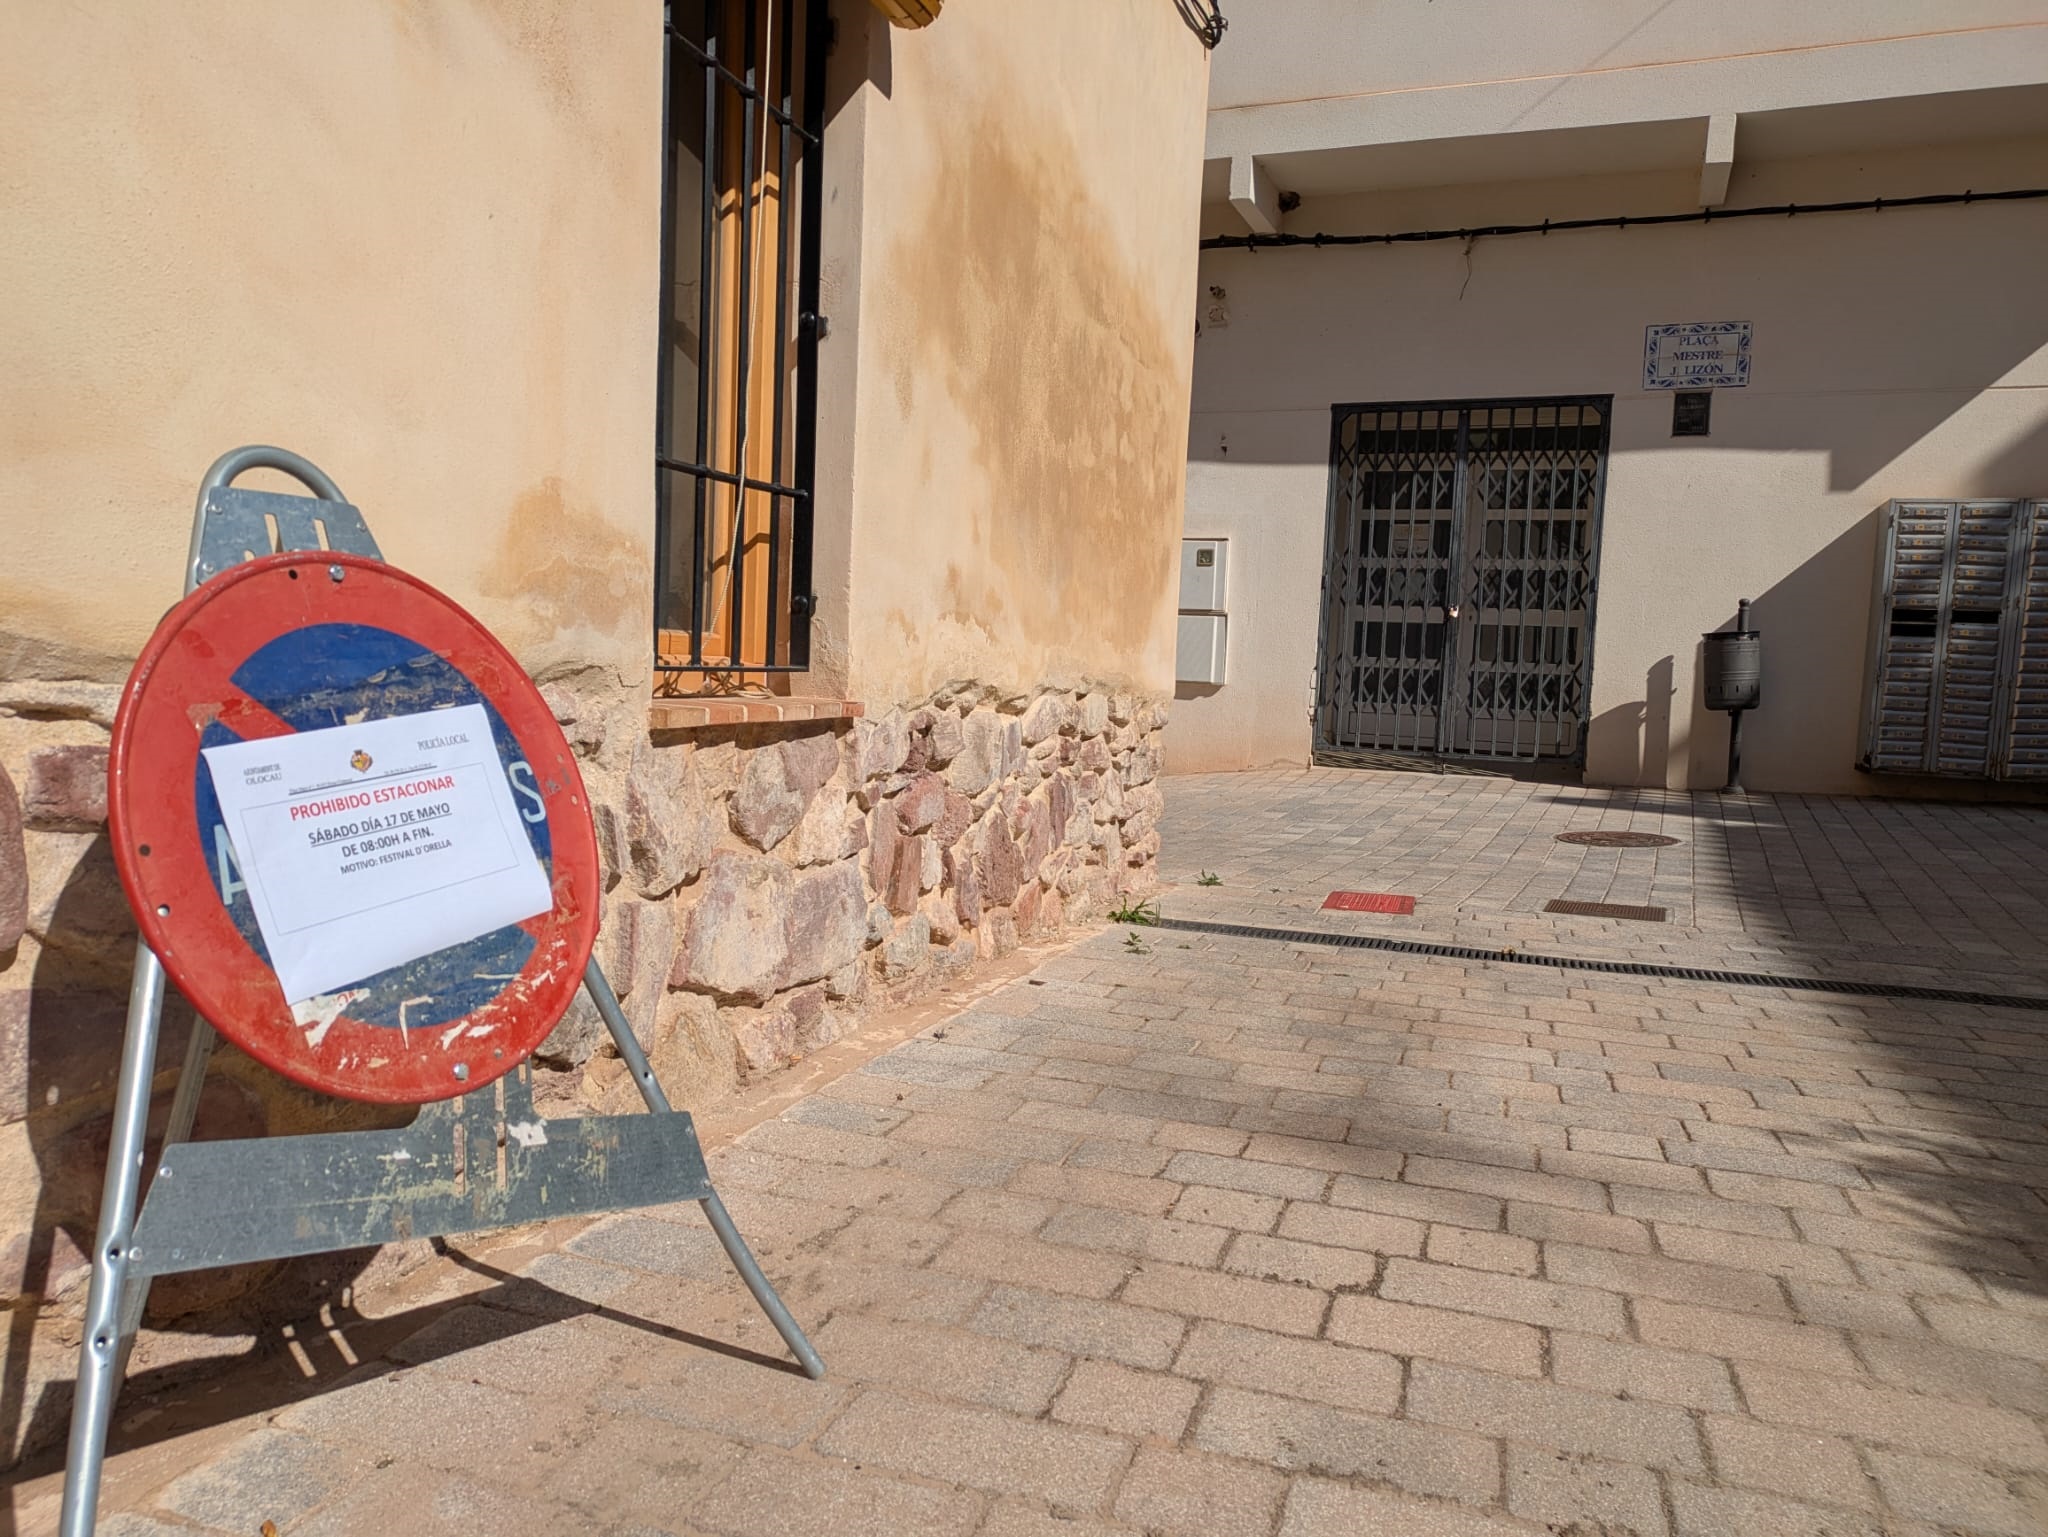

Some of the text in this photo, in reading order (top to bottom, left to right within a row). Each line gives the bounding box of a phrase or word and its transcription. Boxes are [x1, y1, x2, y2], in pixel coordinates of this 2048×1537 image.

[1679, 335, 1719, 347] PLAÇA
[1673, 350, 1724, 362] MESTRE
[1685, 363, 1724, 375] LIZÓN
[445, 733, 470, 746] LOCAL
[245, 772, 282, 786] OLOCAU
[290, 791, 371, 821] PROHIBIDO
[375, 775, 455, 802] ESTACIONAR
[308, 802, 450, 845] SÁBADO DÍA 17 DE MAYO
[341, 826, 434, 858] DE 08:00H A FIN.
[340, 858, 378, 875] MOTIVO:
[379, 848, 415, 864] FESTIVAL
